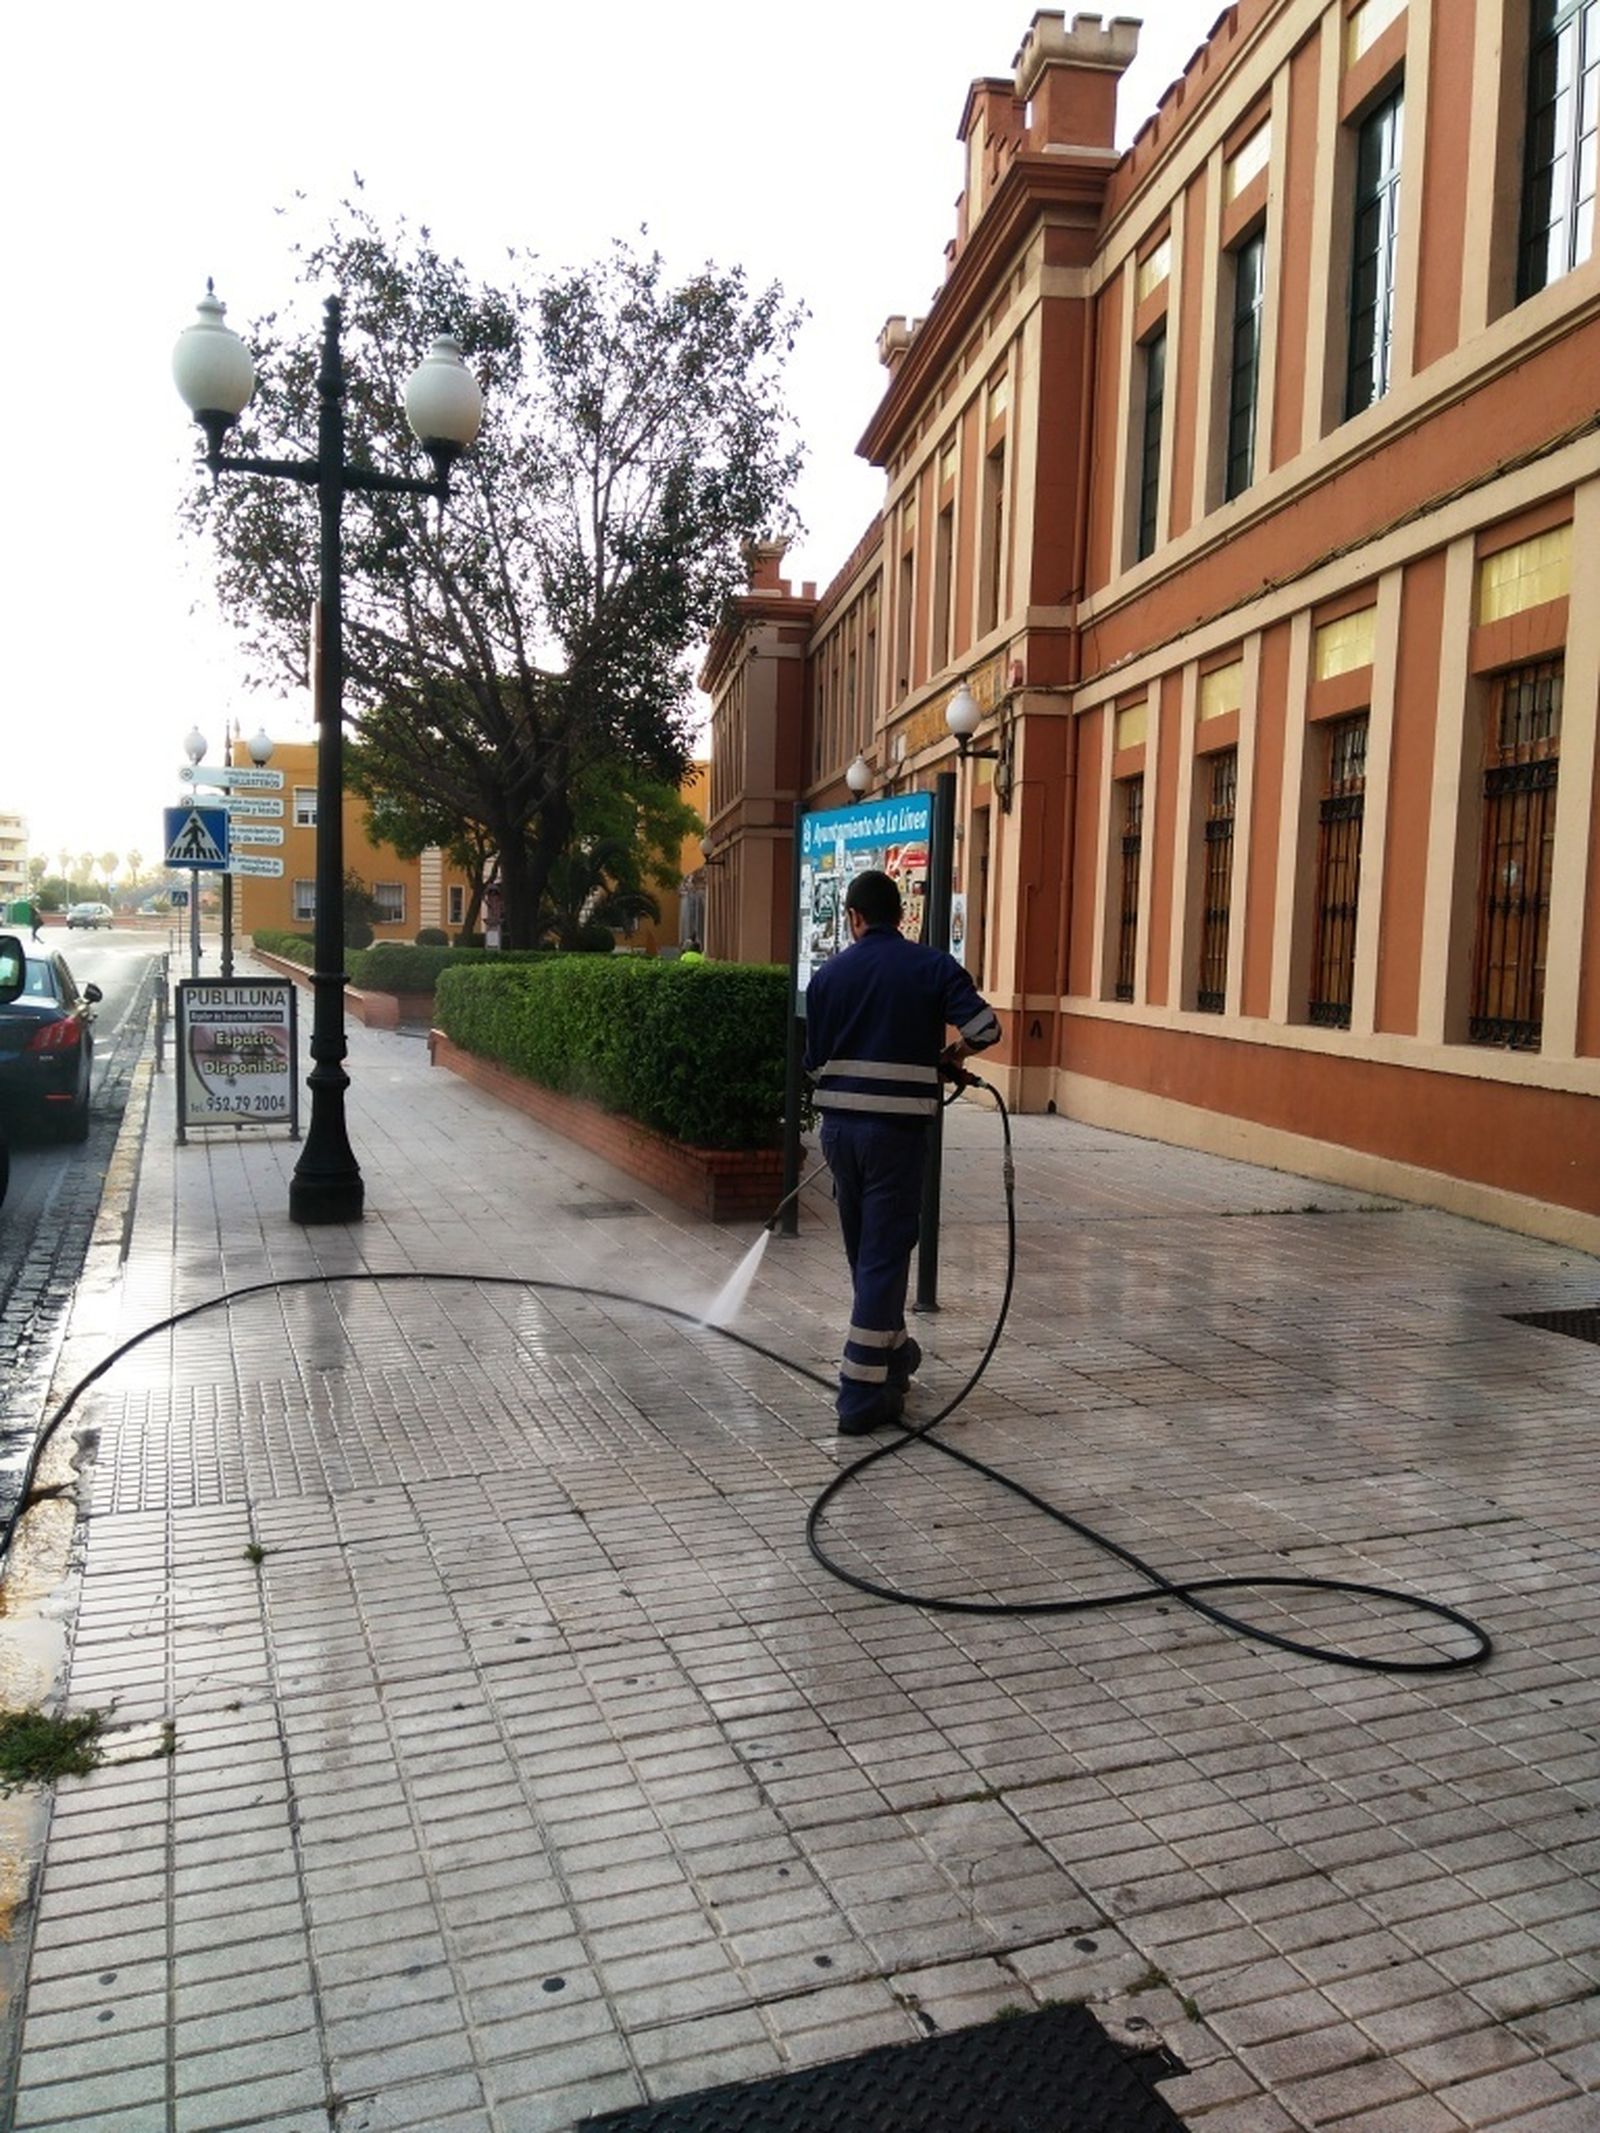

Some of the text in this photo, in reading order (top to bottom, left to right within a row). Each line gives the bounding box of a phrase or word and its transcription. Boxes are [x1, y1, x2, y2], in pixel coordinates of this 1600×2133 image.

[812, 816, 872, 848] Ayuntamiento
[873, 811, 886, 835] de
[886, 810, 899, 834] La
[186, 989, 287, 1006] PUBLILUNA
[215, 1031, 275, 1048] Espacio
[203, 1060, 288, 1076] Disponible
[254, 1094, 286, 1111] 2004
